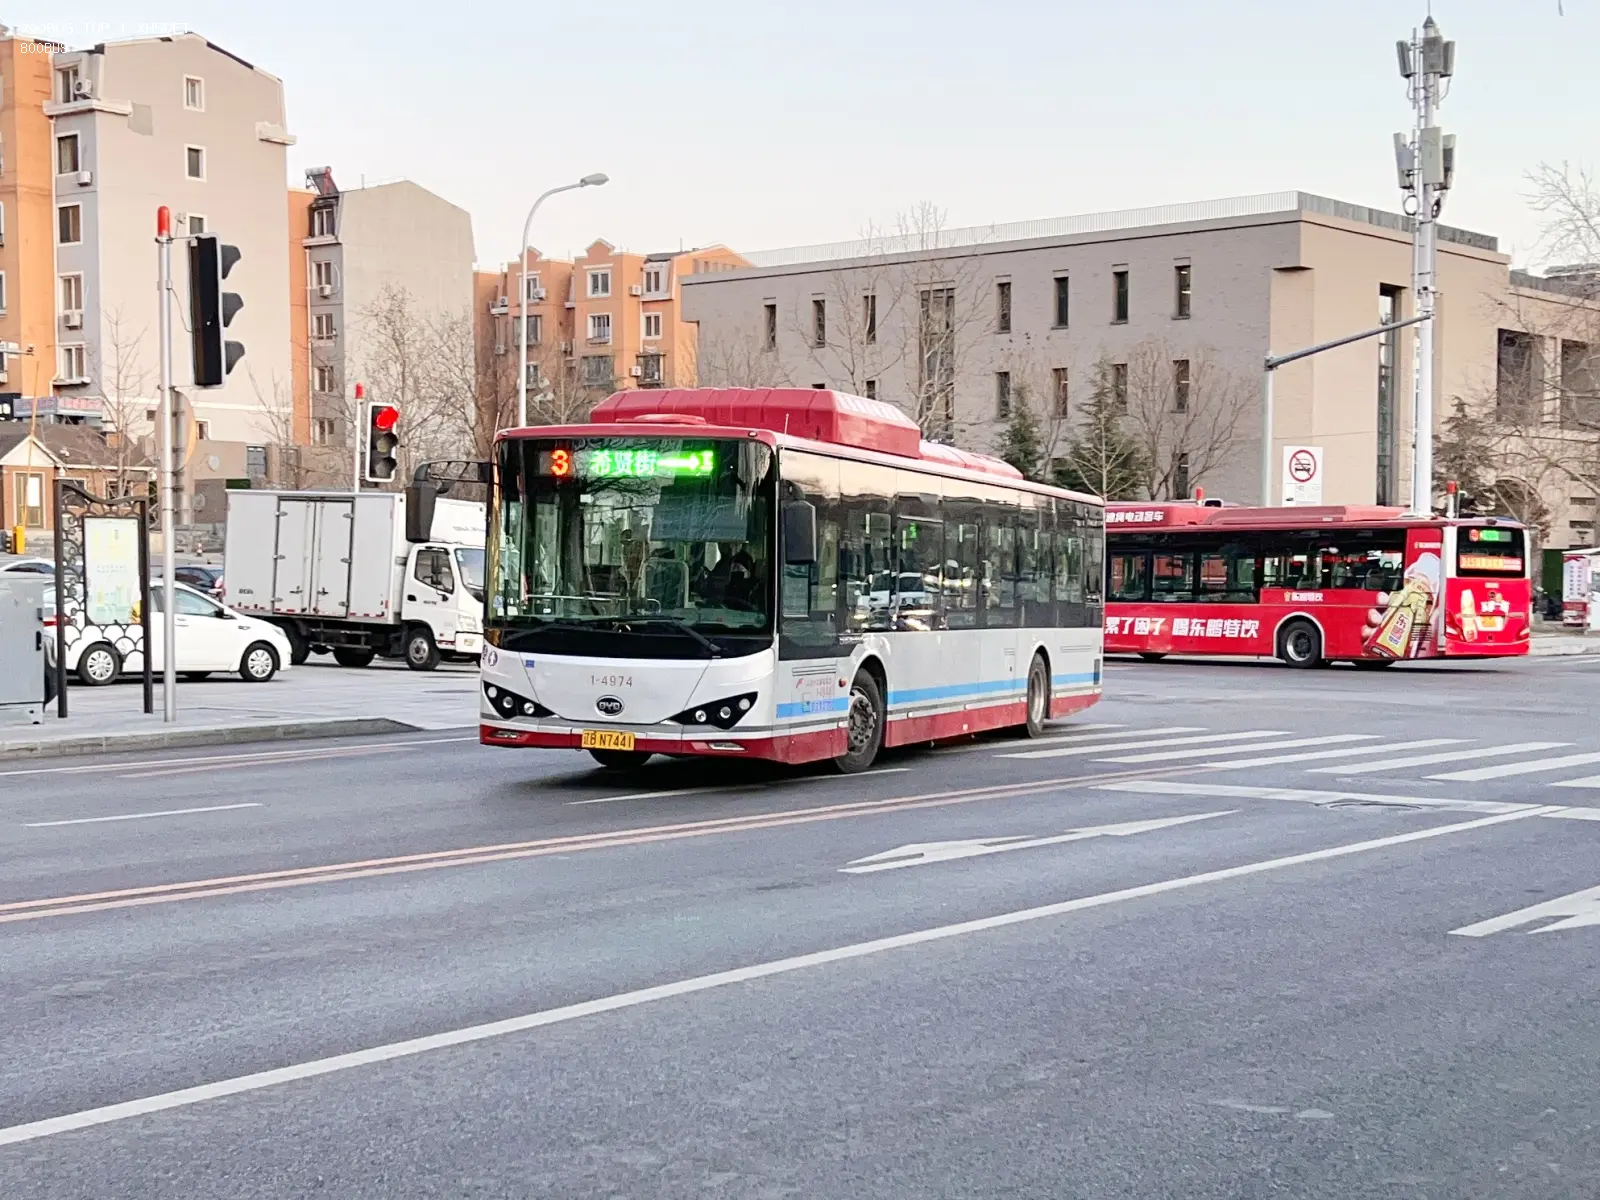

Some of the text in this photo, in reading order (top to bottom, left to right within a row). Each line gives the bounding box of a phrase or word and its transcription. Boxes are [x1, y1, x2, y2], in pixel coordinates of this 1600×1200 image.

[551, 450, 568, 476] 3
[591, 674, 633, 687] 1-4974
[599, 701, 620, 711] BYD
[599, 733, 632, 749] N7441
